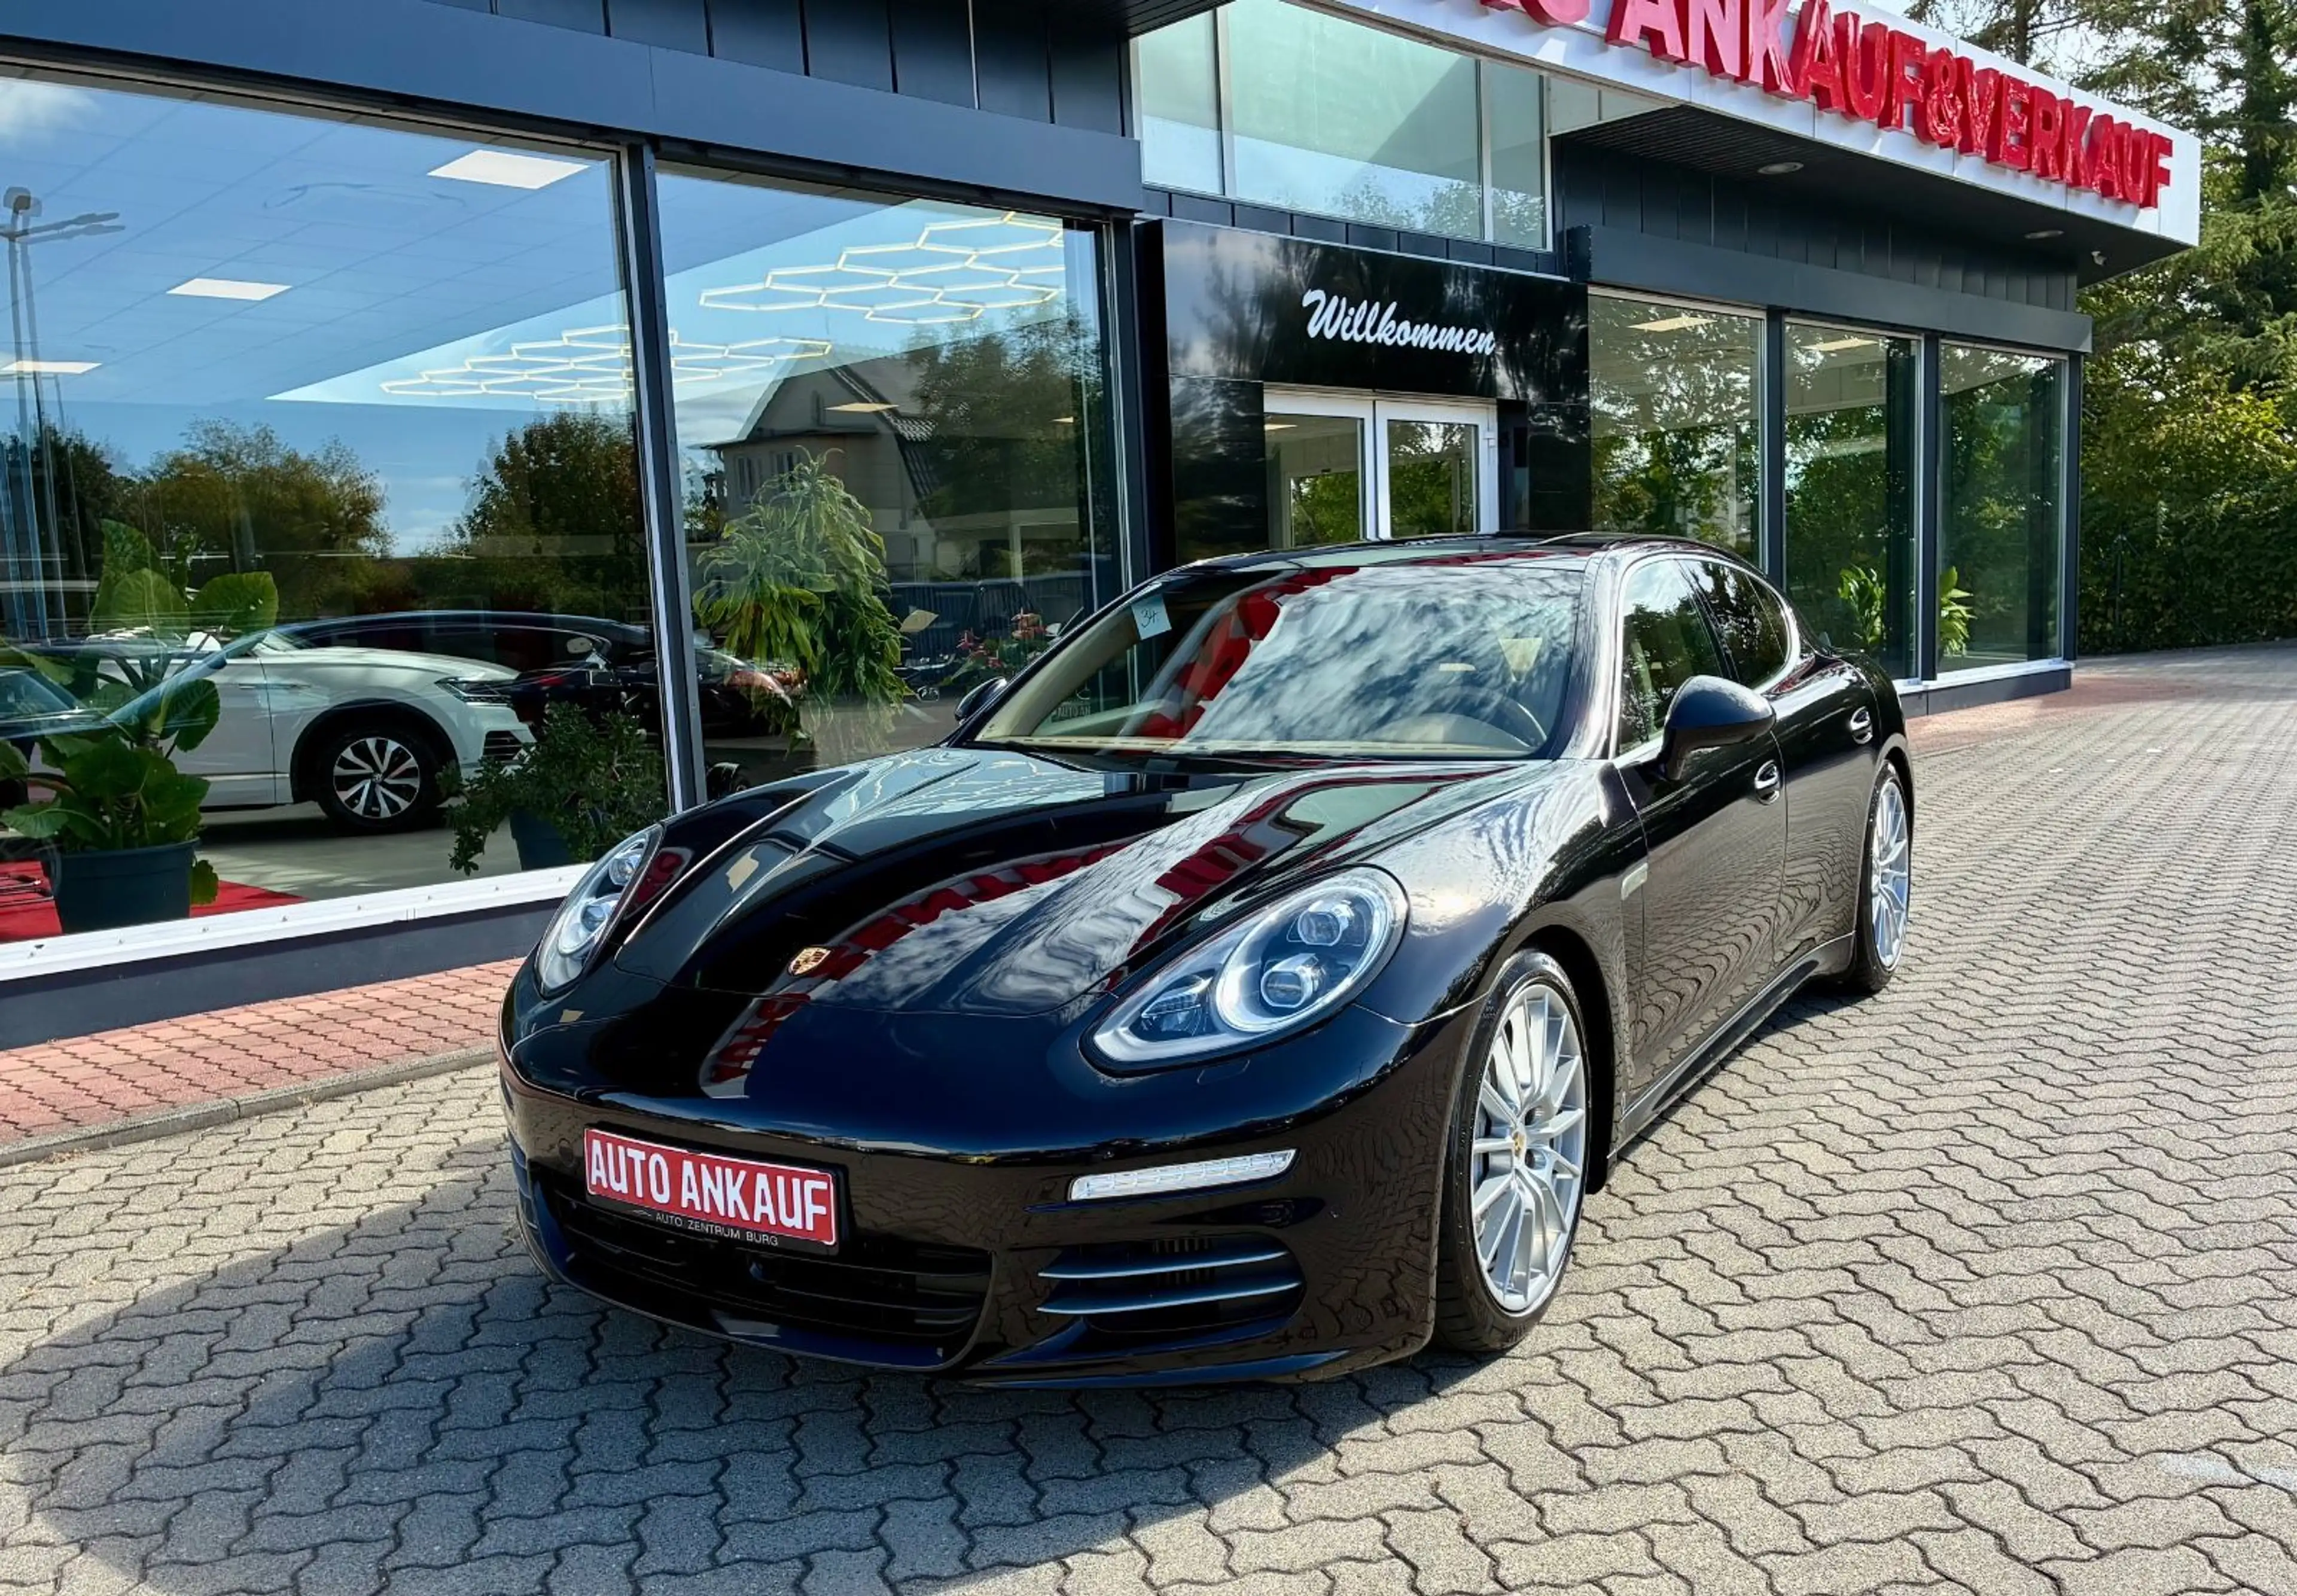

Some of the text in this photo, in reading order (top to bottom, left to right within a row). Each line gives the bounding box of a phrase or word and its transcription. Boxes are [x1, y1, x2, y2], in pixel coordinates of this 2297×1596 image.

[1302, 288, 1495, 355] Willkommen
[591, 1140, 828, 1231] AUTO ANKAUF
[656, 1213, 778, 1246] AUTO ZENTRUM BURG
